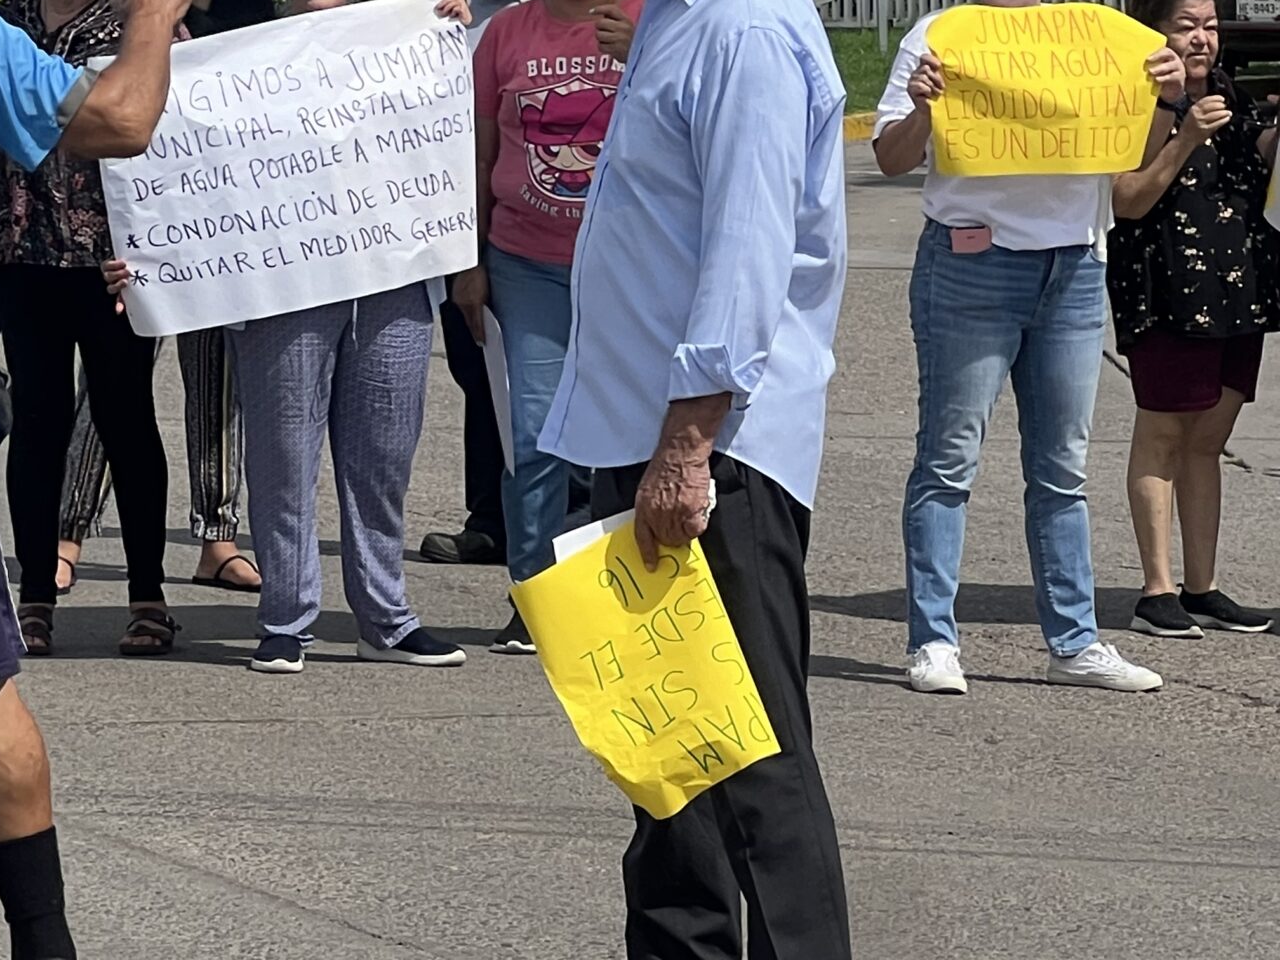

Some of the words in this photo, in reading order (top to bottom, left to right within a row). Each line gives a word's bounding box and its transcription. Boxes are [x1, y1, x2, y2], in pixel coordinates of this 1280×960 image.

[975, 8, 1107, 45] JUMAPAM
[164, 63, 302, 117] IGIMOS
[316, 57, 334, 90] A
[342, 24, 468, 91] JUMAPAM
[942, 47, 1041, 82] QUITAR
[1050, 46, 1122, 78] AGUA
[944, 87, 1058, 121] LIQUIDO
[1068, 83, 1148, 119] VITAL
[132, 176, 165, 203] DE
[181, 163, 239, 196] AGUA
[249, 143, 343, 190] POTABLE
[355, 138, 370, 164] A
[376, 112, 464, 154] MANGOS
[945, 127, 980, 161] ES
[990, 127, 1029, 161] UN
[1040, 125, 1132, 160] DELITO
[347, 186, 378, 216] DE
[565, 206, 585, 218] th
[158, 251, 256, 284] QUITAR
[262, 246, 295, 269] EL
[299, 222, 403, 261] MEDIDOR
[597, 555, 645, 608] 16
[579, 640, 625, 692] EL
[611, 669, 699, 747] SIN
